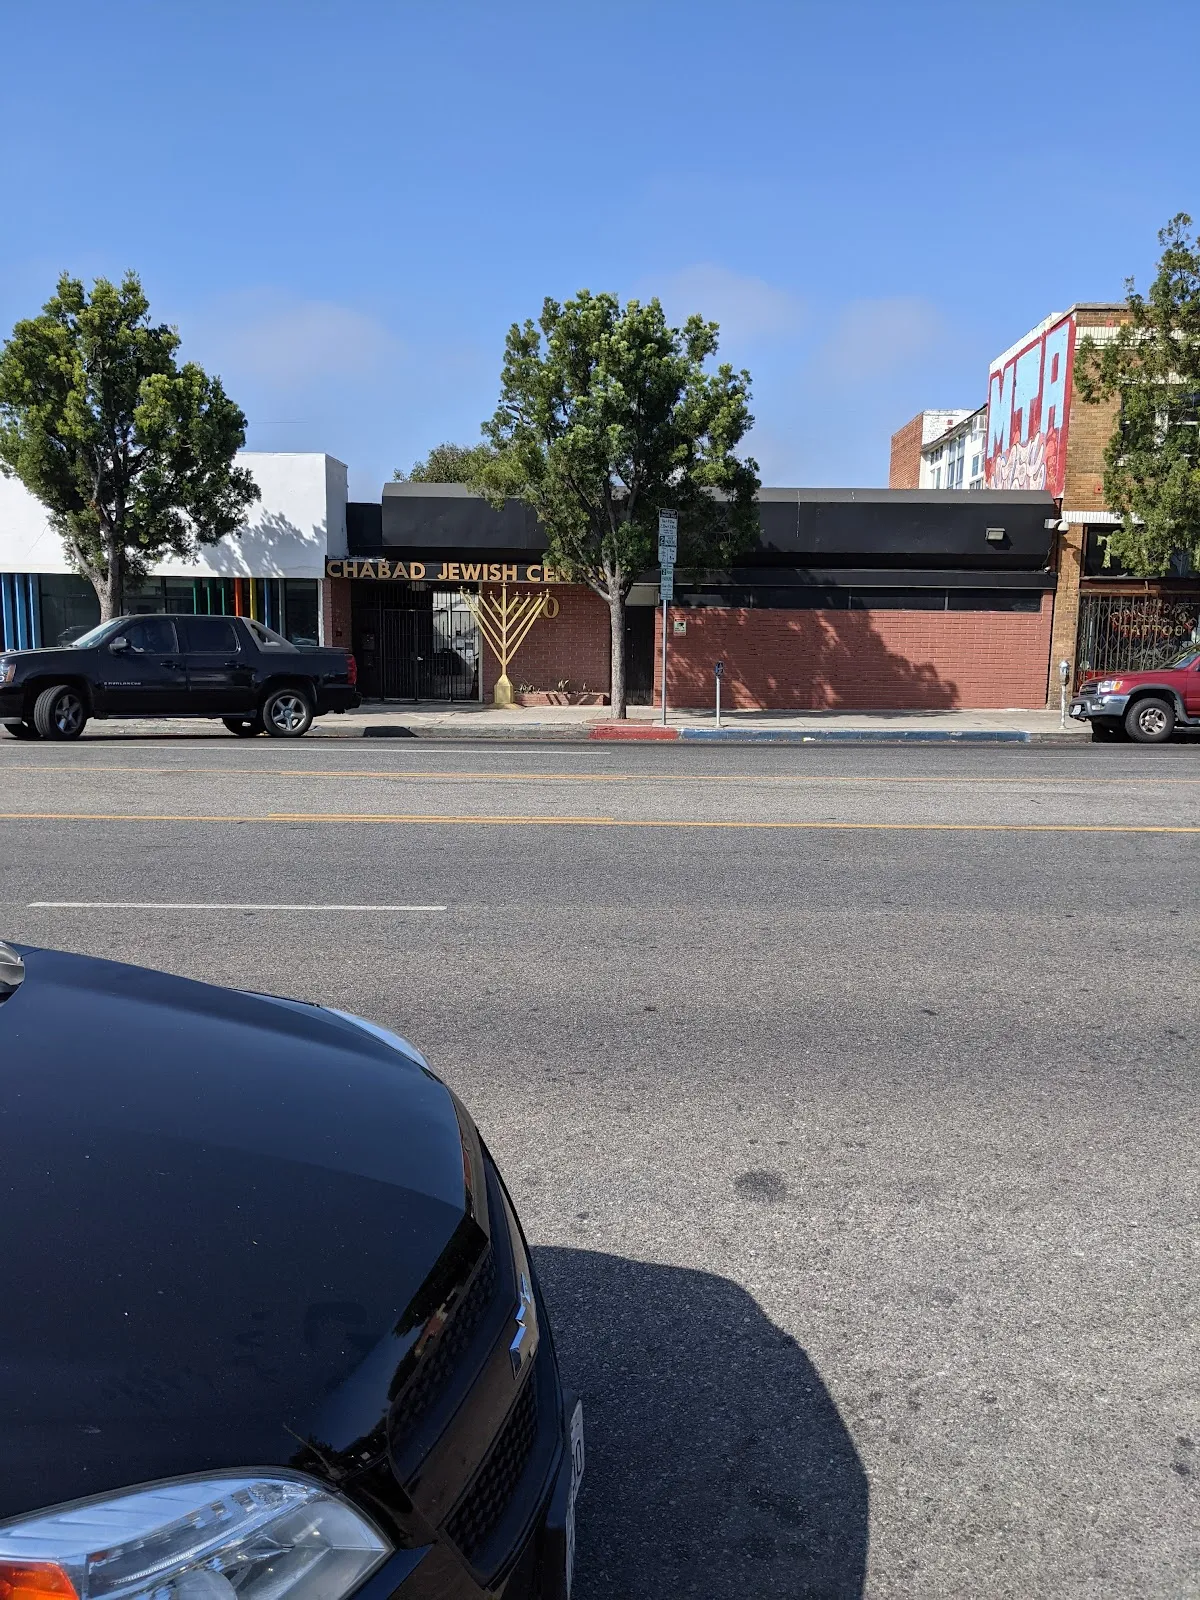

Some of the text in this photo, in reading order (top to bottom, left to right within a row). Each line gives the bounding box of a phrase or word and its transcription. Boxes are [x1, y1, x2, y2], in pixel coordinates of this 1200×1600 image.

[326, 559, 426, 580] CHABAD
[437, 562, 517, 581] JEWISH
[1120, 624, 1183, 637] TATTOO
